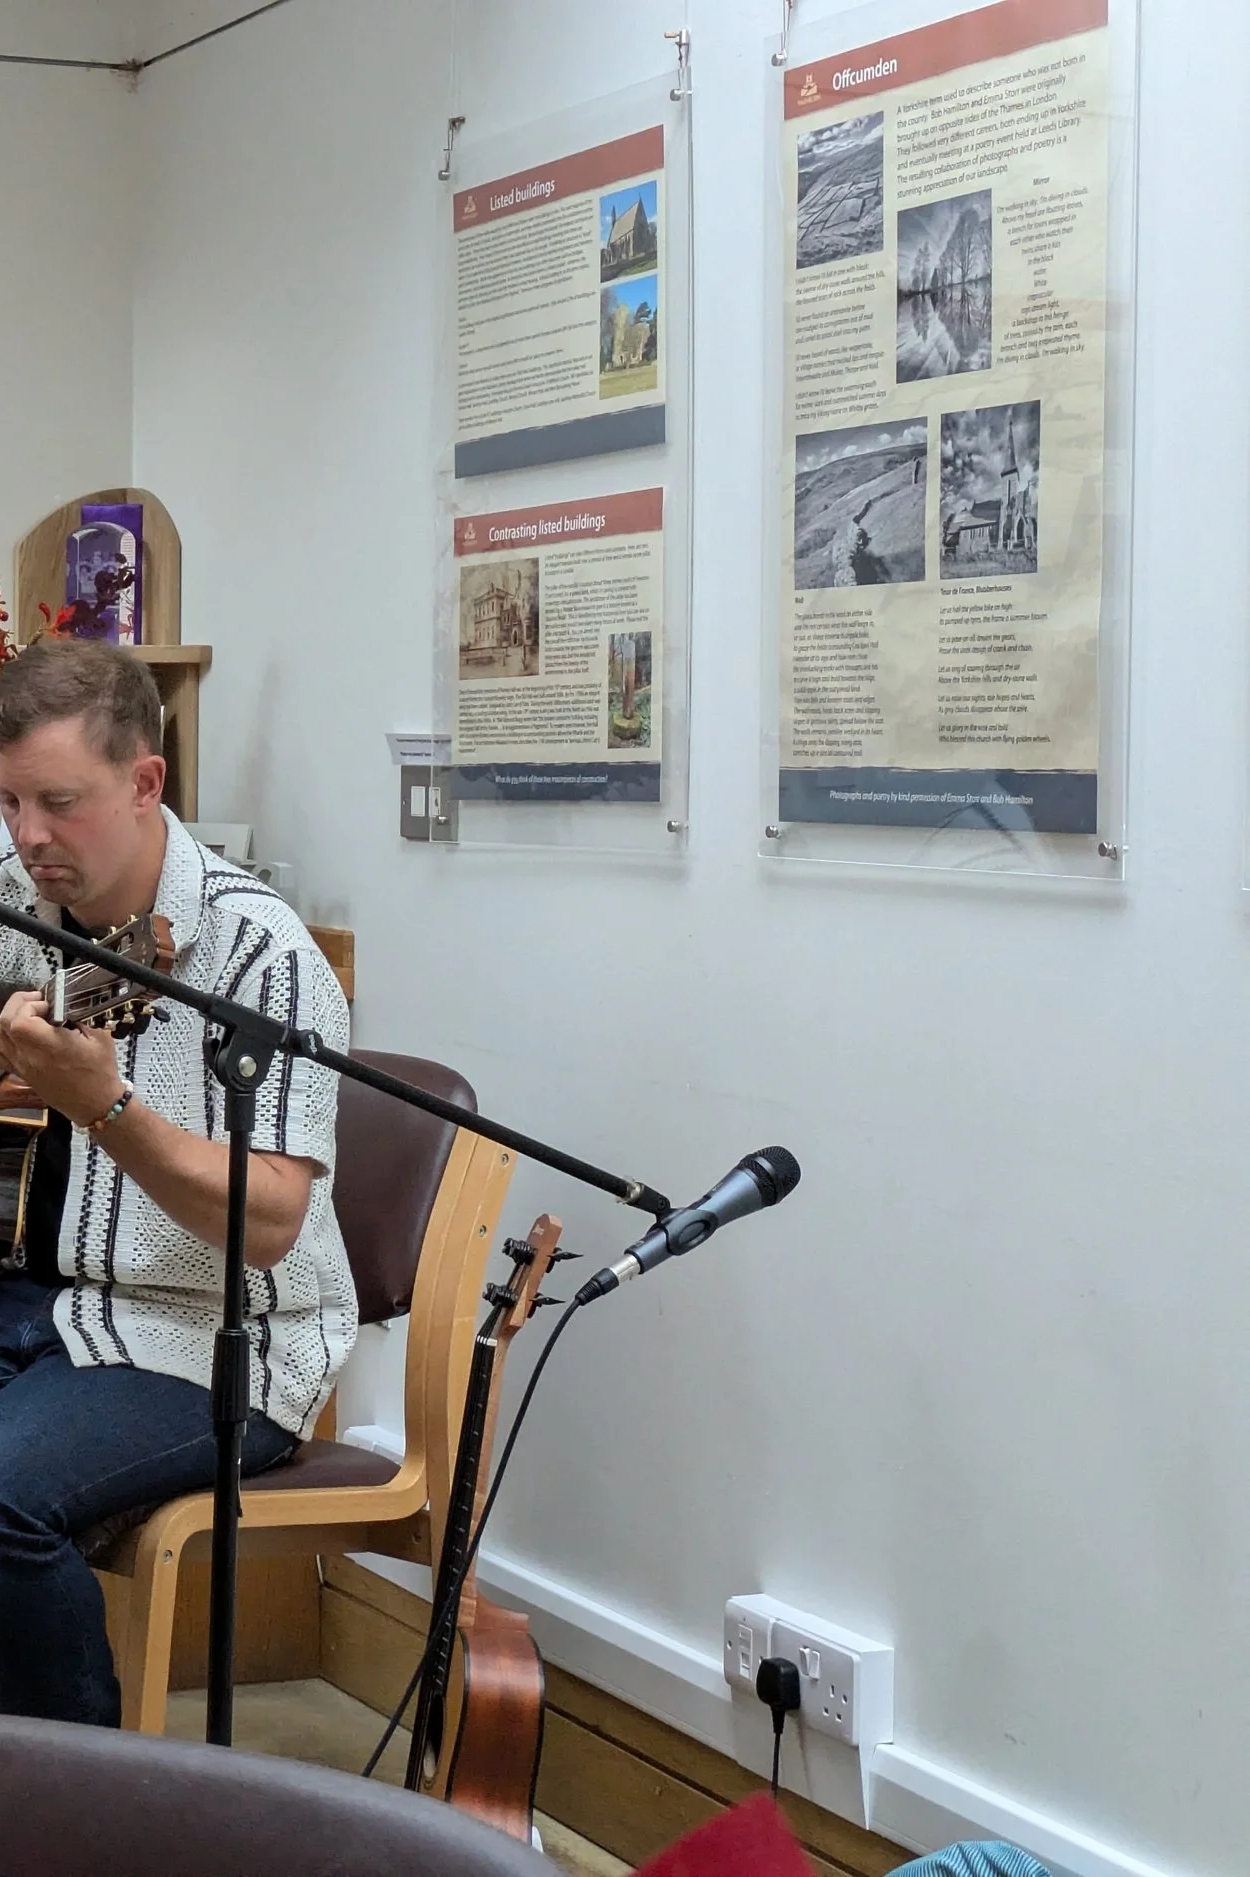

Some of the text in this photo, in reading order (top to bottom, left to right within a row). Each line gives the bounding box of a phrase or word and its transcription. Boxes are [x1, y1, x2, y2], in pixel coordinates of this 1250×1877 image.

[832, 57, 898, 91] Offcumden
[491, 180, 555, 210] Listed buildings
[489, 514, 605, 541] Contrasting listed buildings
